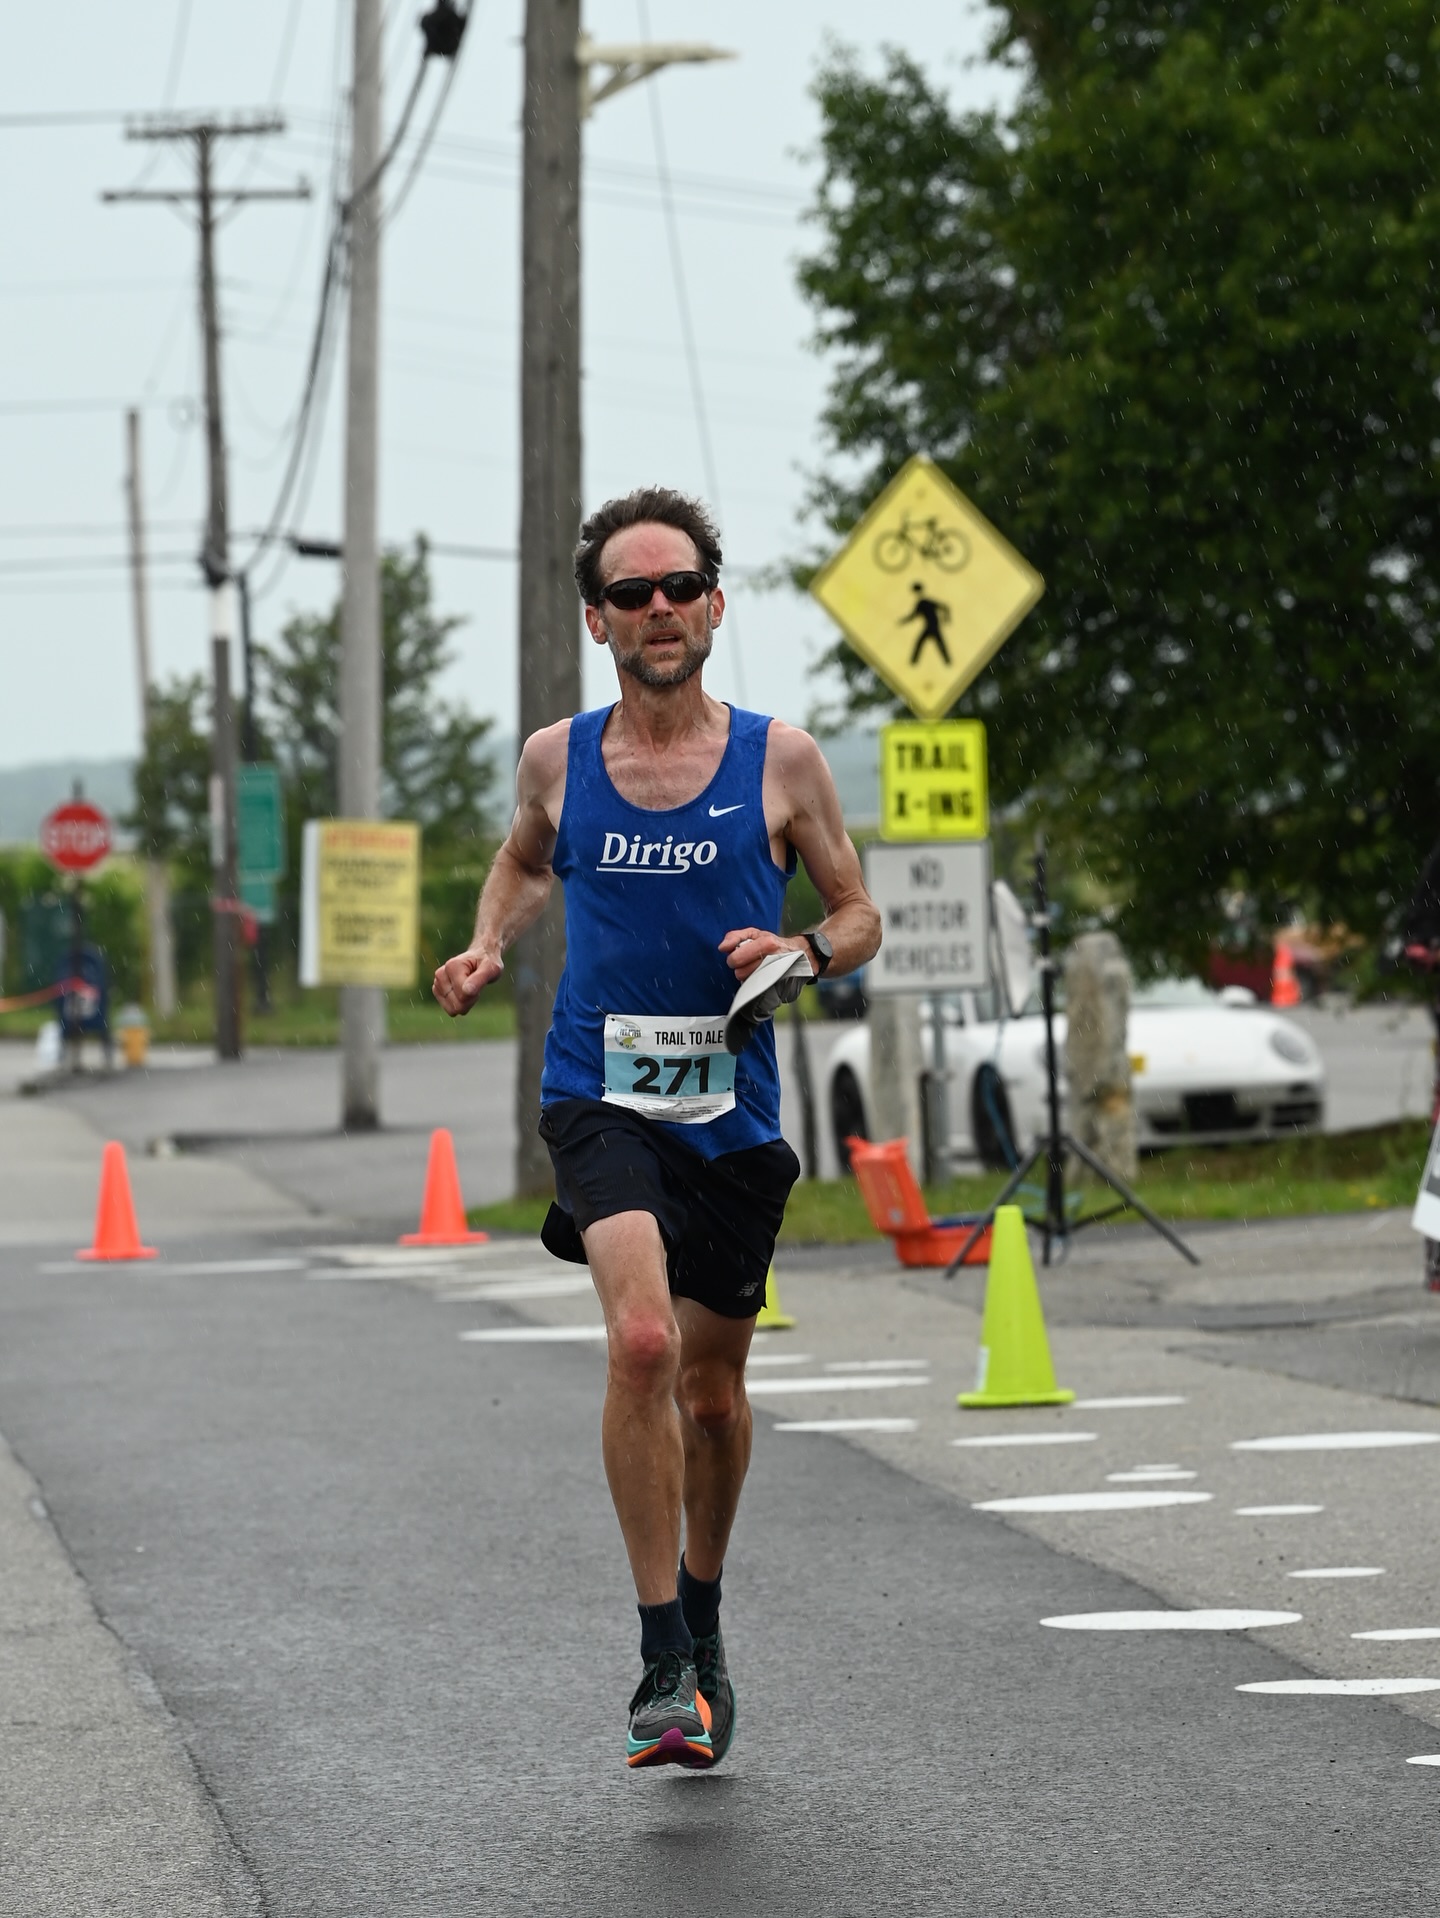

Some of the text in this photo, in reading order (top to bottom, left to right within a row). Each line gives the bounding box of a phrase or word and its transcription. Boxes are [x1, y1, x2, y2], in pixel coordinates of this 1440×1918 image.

[895, 742, 968, 772] TRAIL
[895, 790, 974, 819] X-ING
[48, 822, 107, 854] STOP
[596, 832, 718, 874] Dirigo
[908, 859, 944, 890] NO
[888, 904, 967, 931] MOTOR
[884, 945, 974, 976] VEHICLES
[655, 1031, 686, 1046] TRAIL
[689, 1031, 702, 1045] TO
[705, 1030, 724, 1044] ALE
[632, 1056, 710, 1095] 271
